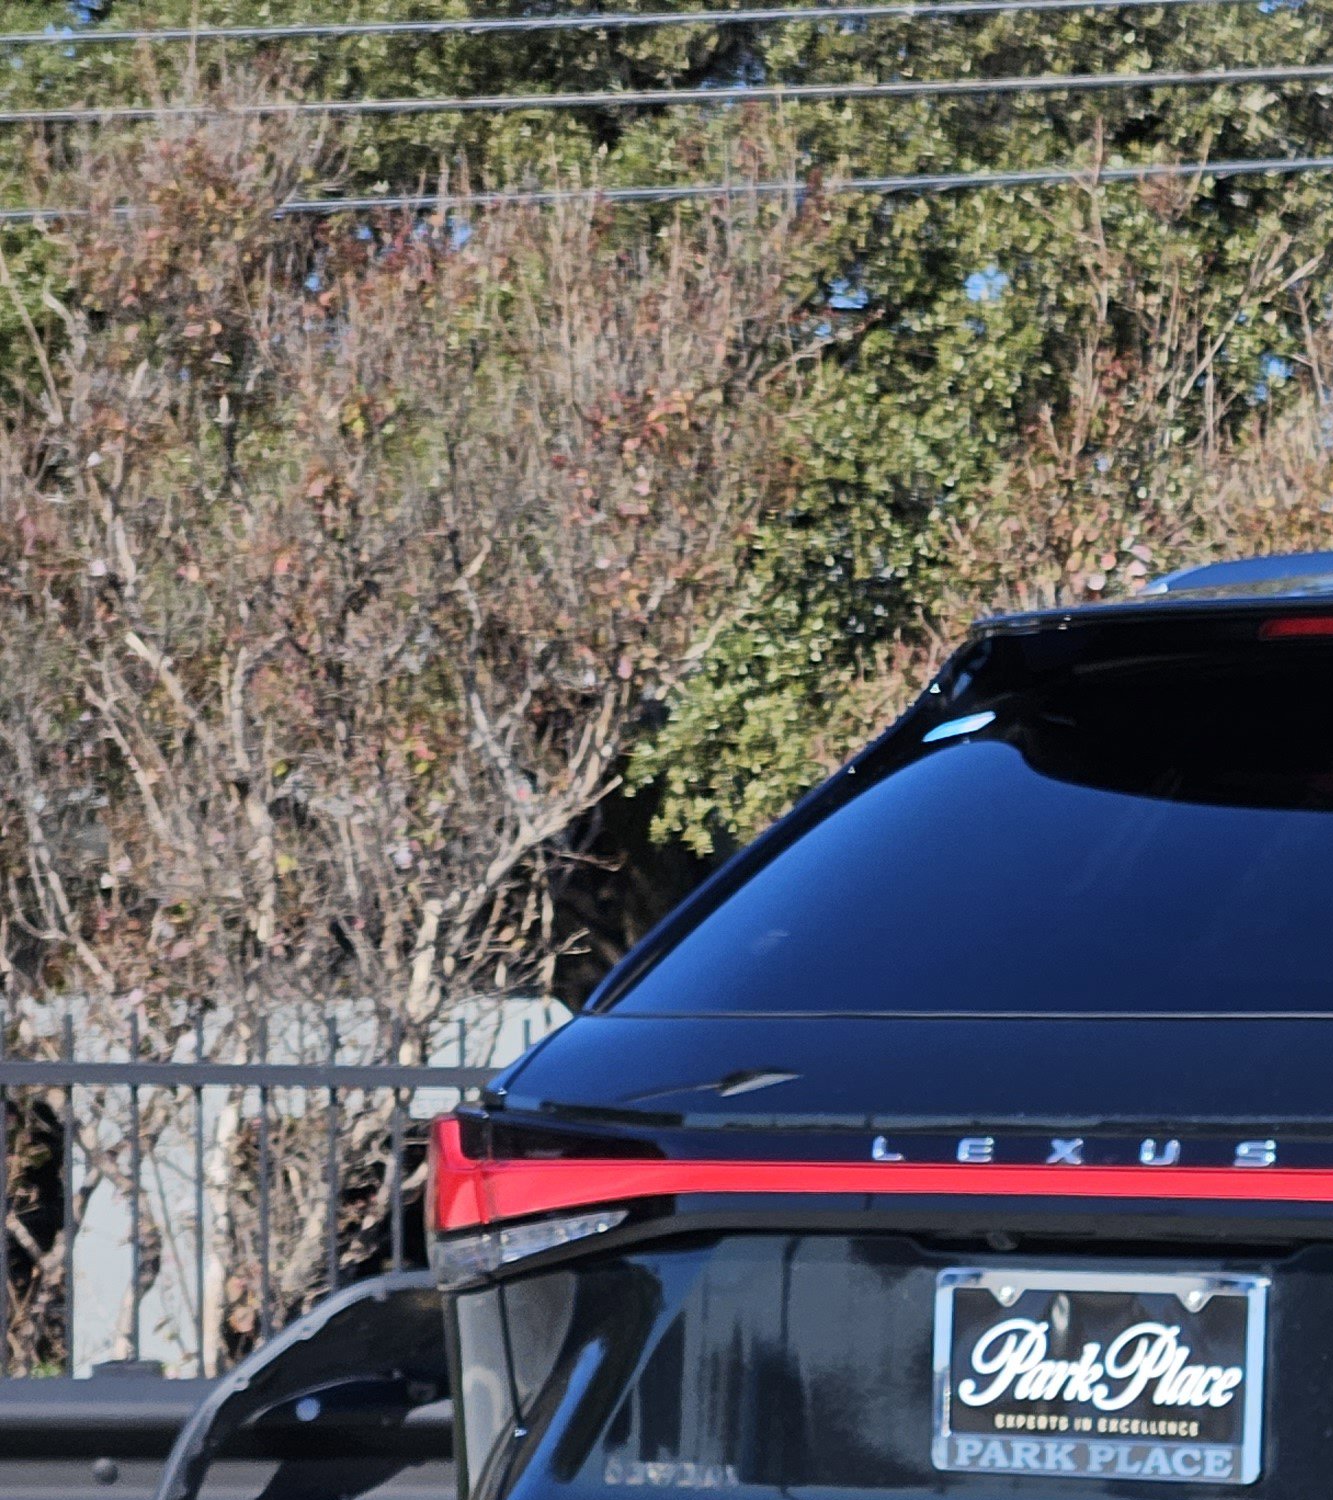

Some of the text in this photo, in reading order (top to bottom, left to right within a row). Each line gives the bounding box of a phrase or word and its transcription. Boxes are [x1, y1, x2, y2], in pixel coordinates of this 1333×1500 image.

[871, 1135, 1277, 1167] LEXUS
[958, 1317, 1243, 1411] Park Place
[955, 1439, 1234, 1479] PARK PLACE
